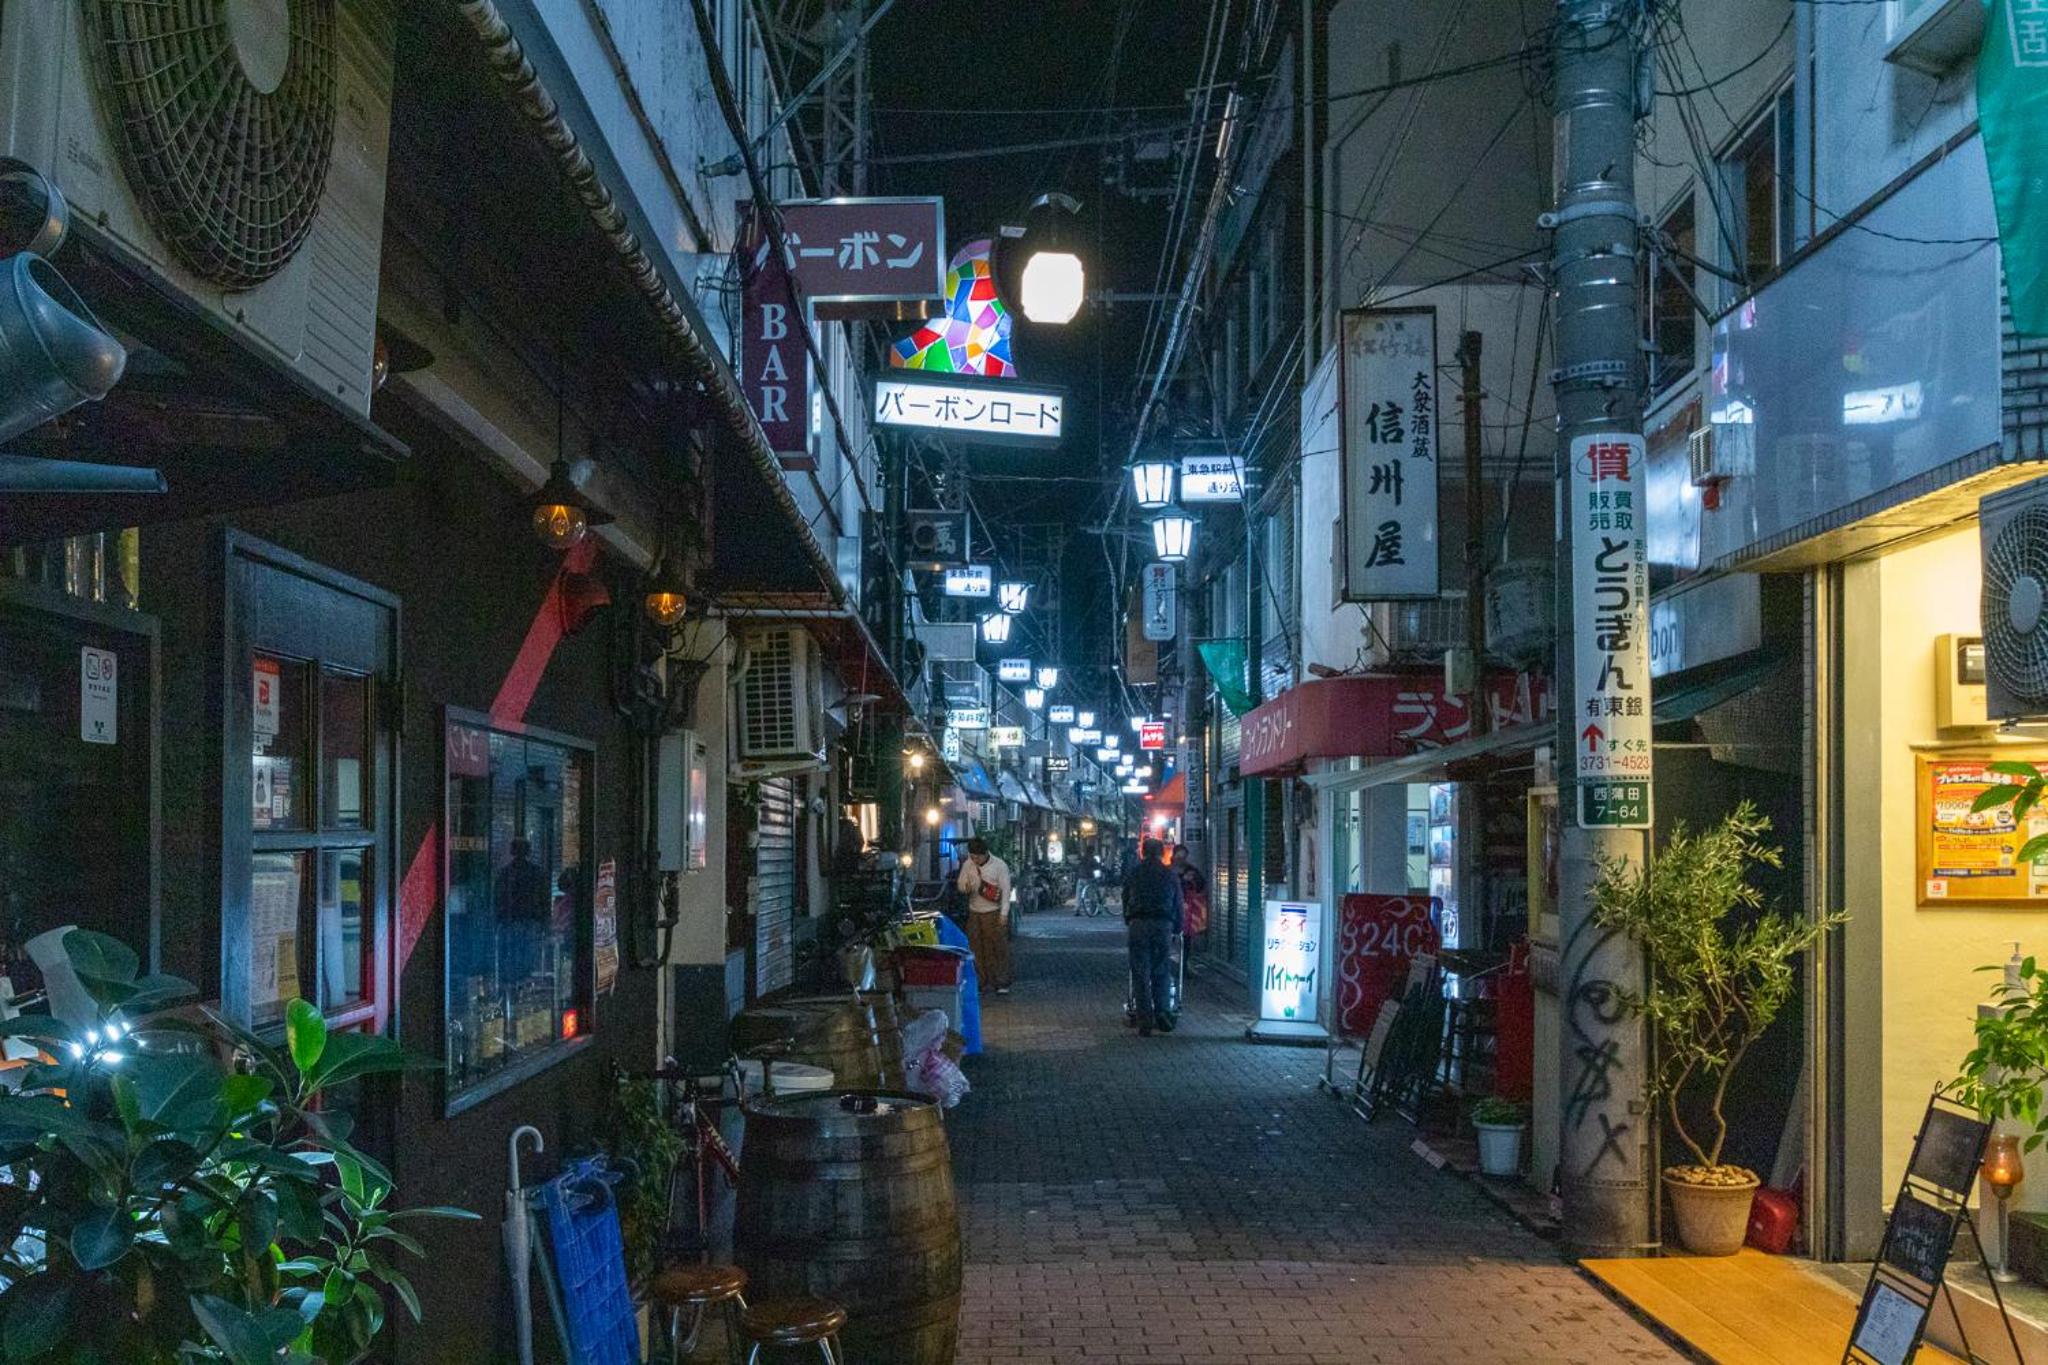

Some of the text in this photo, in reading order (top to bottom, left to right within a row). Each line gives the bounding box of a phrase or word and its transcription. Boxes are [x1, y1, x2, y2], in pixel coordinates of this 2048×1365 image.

[756, 231, 924, 271] バーボン
[760, 303, 790, 422] BAR
[879, 391, 1060, 429] バーボンロード
[1588, 443, 1632, 482] 質
[1364, 400, 1406, 569] 信州屋
[1594, 537, 1634, 692] とうぎん
[1581, 756, 1650, 770] 3731-4523
[1607, 739, 1648, 752] すぐ先
[1594, 787, 1640, 801] 西蒲田
[1596, 806, 1639, 819] 7-64
